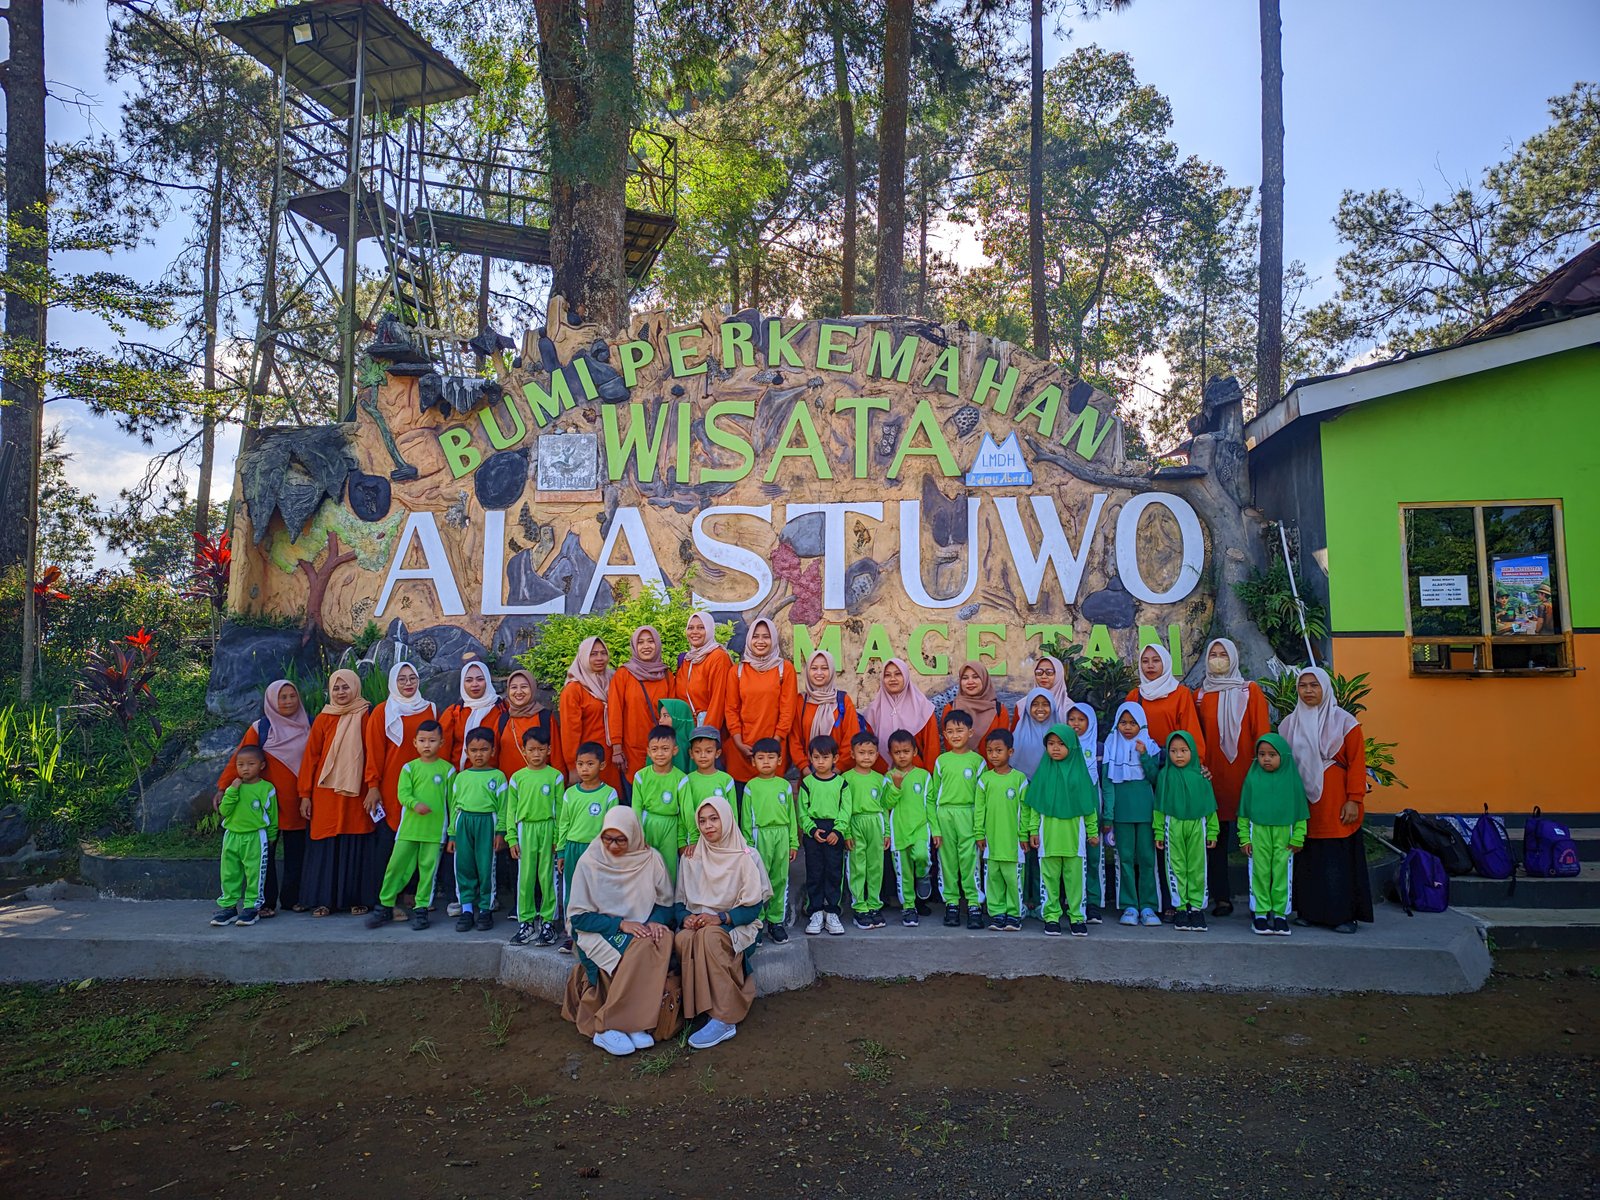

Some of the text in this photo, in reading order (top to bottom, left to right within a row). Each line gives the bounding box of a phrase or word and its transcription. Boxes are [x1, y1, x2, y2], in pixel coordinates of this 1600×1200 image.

[438, 320, 1114, 481] BUMI PERKEMAHAN
[601, 396, 961, 484] WISATA
[982, 453, 1016, 467] LMDH
[374, 492, 1205, 617] ALASTUWO
[793, 623, 1184, 676] MAGETAN
